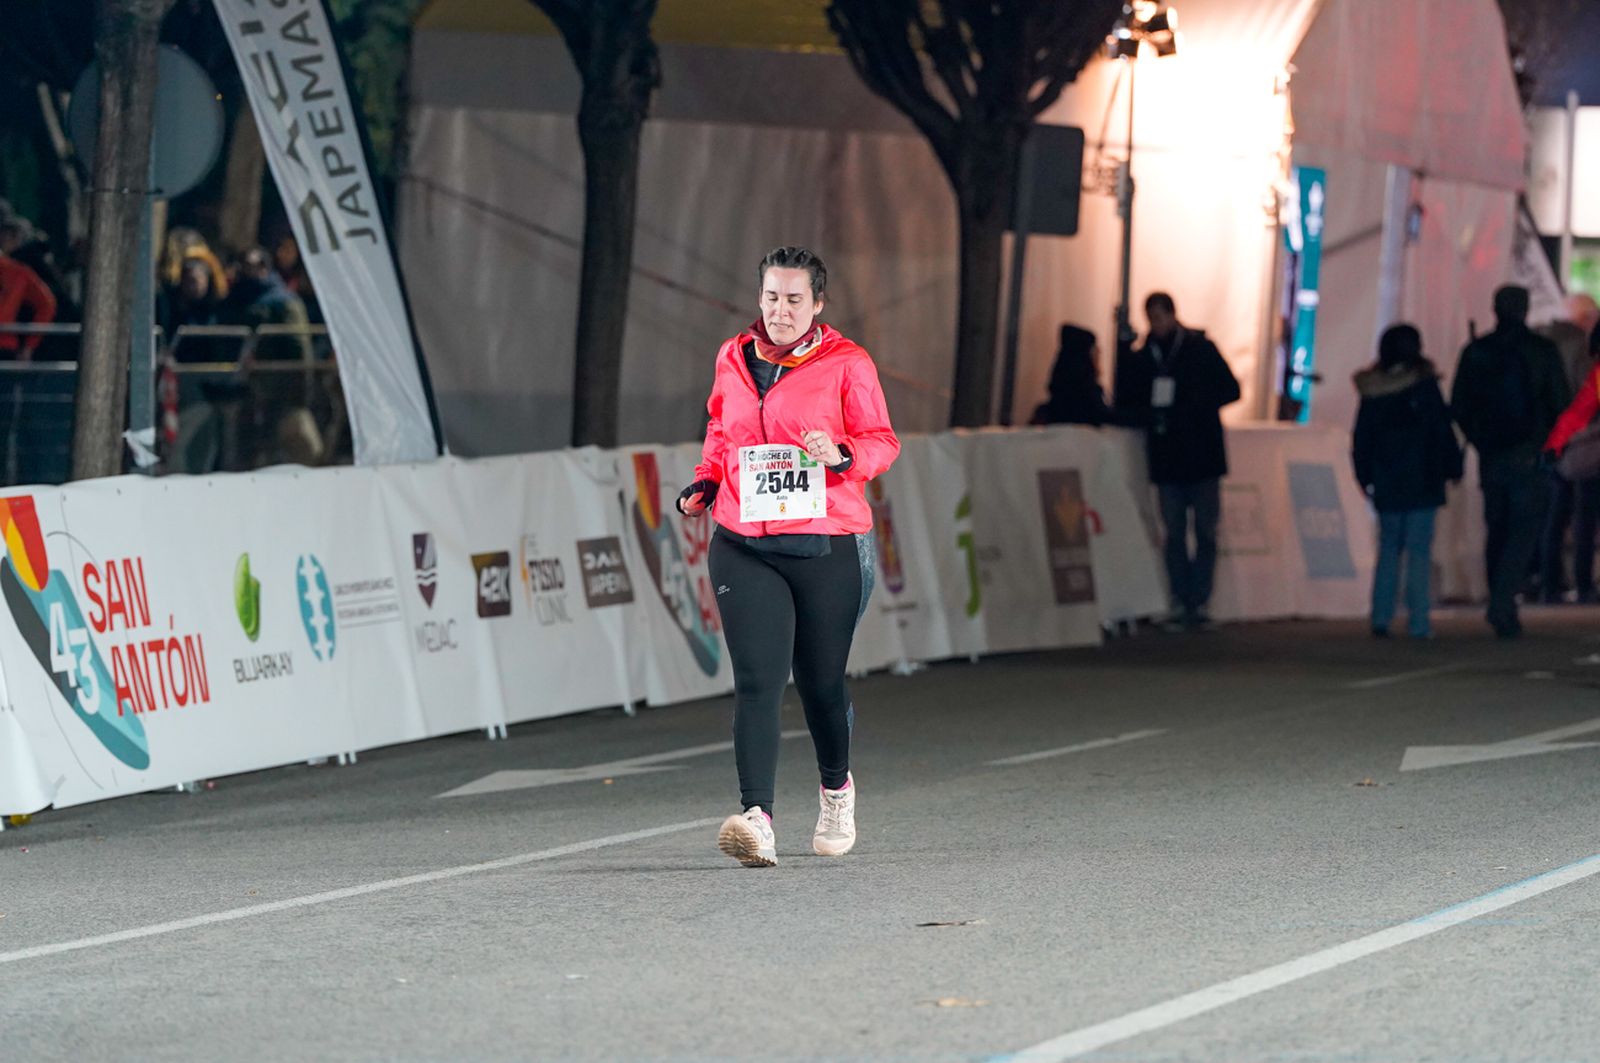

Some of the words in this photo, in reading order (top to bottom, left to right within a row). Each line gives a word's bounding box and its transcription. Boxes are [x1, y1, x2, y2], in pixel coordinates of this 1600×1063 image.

[749, 463, 764, 472] SAN
[765, 459, 793, 470] ANTÓN
[782, 450, 792, 460] DE
[756, 470, 810, 495] 2544
[82, 556, 152, 634] SAN
[49, 601, 101, 716] 43
[110, 613, 211, 717] ANTÓN
